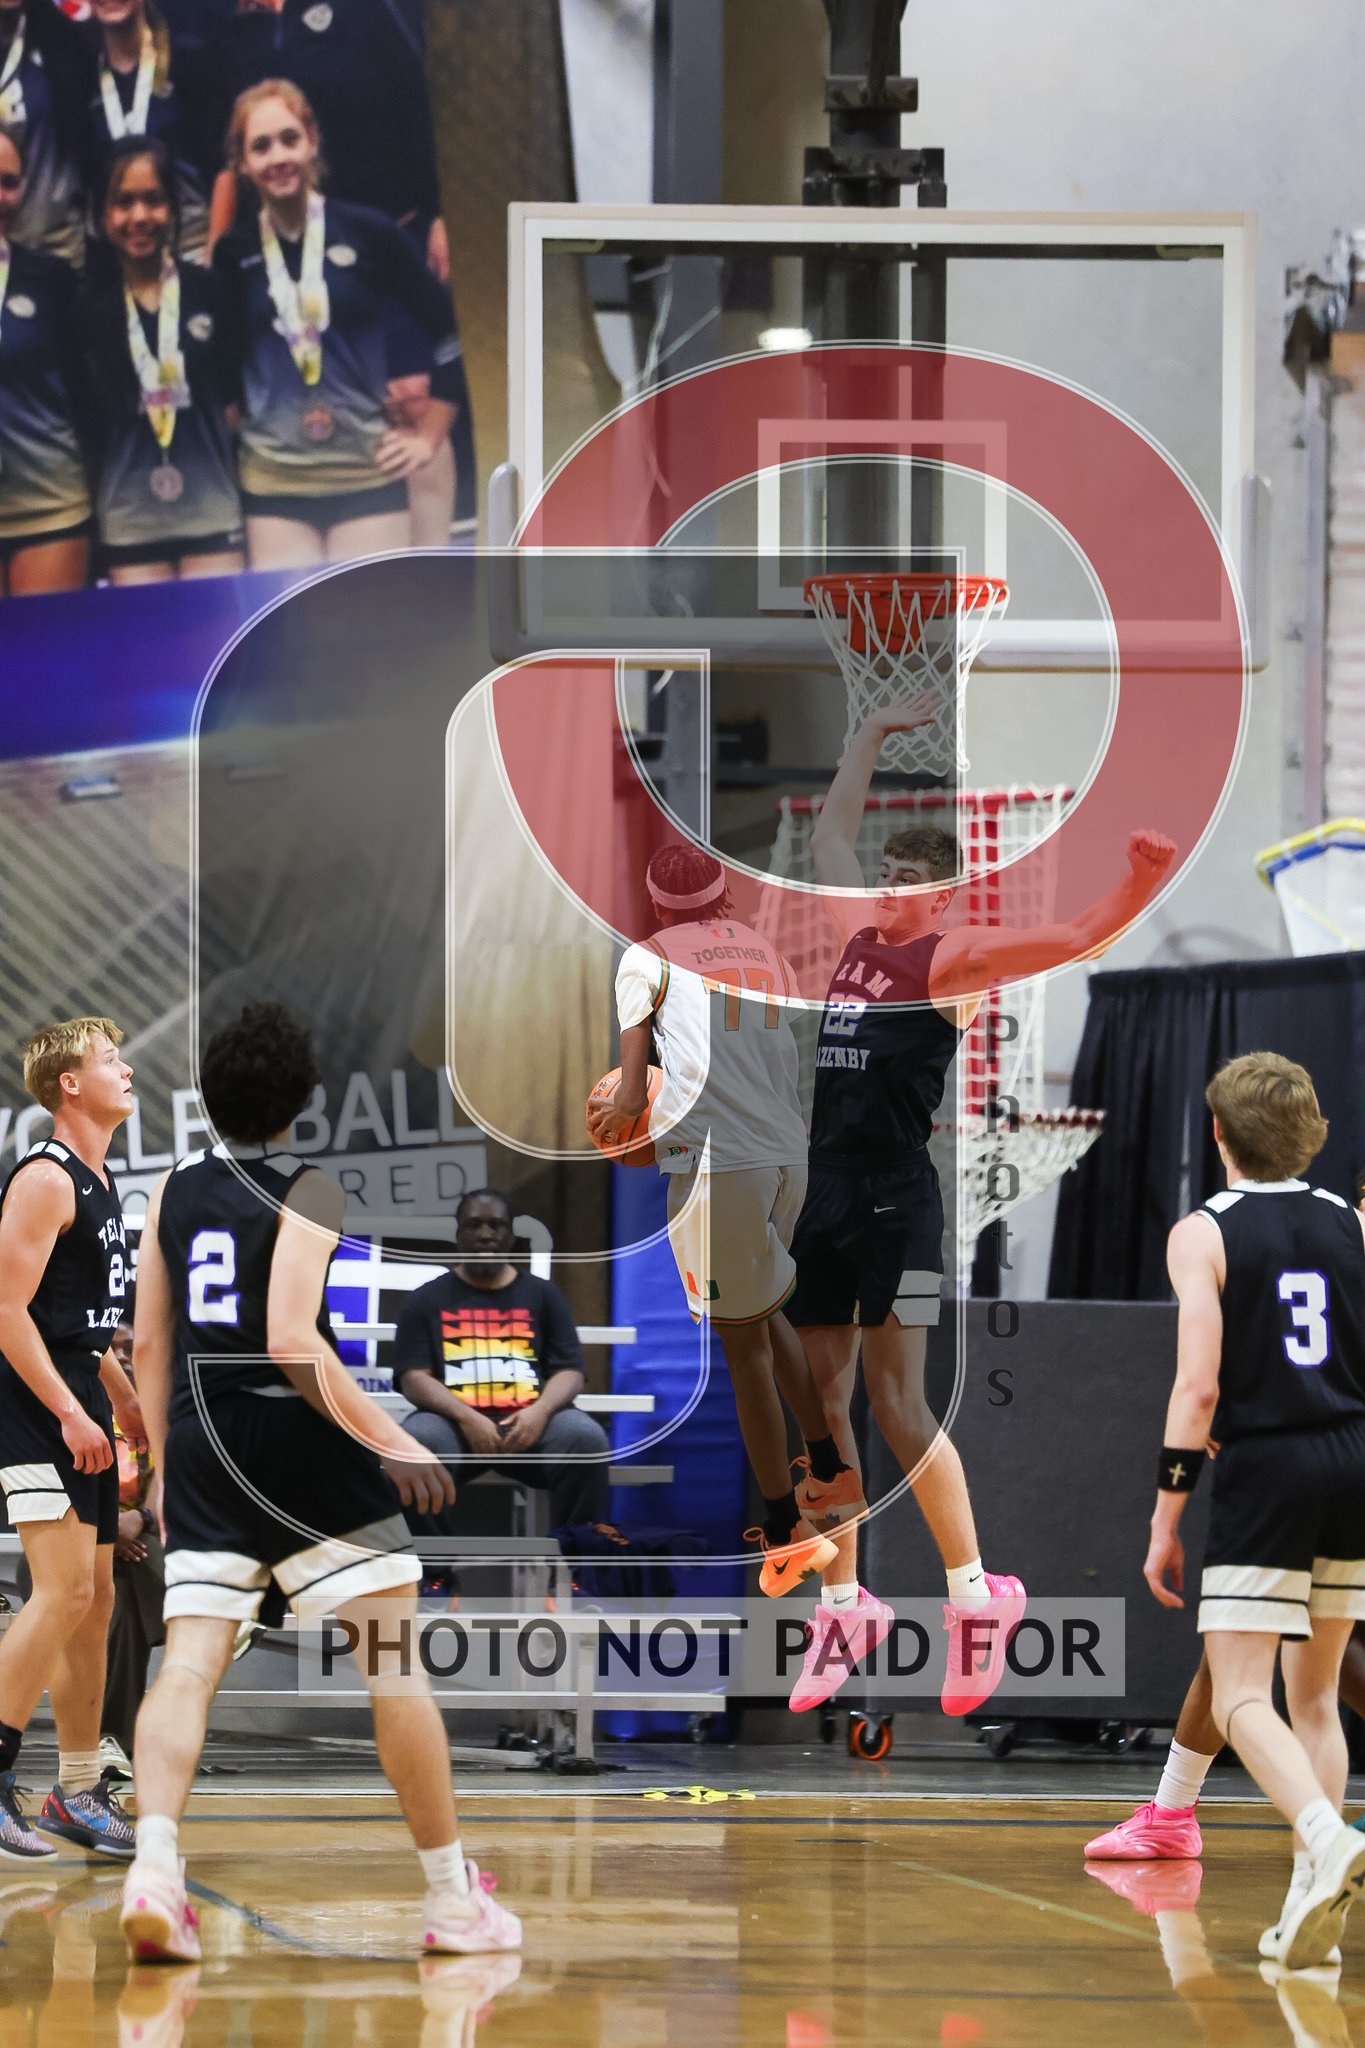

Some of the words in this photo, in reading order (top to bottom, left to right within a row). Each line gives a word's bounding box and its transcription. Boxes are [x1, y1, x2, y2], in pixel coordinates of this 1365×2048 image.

[691, 945, 769, 966] TOGETHER
[701, 967, 780, 1032] 77
[835, 960, 894, 999] EAM
[822, 992, 869, 1037] 22
[816, 1046, 871, 1071] ZENBY
[187, 1227, 241, 1327] 2
[1276, 1268, 1331, 1369] 3
[444, 1358, 539, 1386] NIKE
